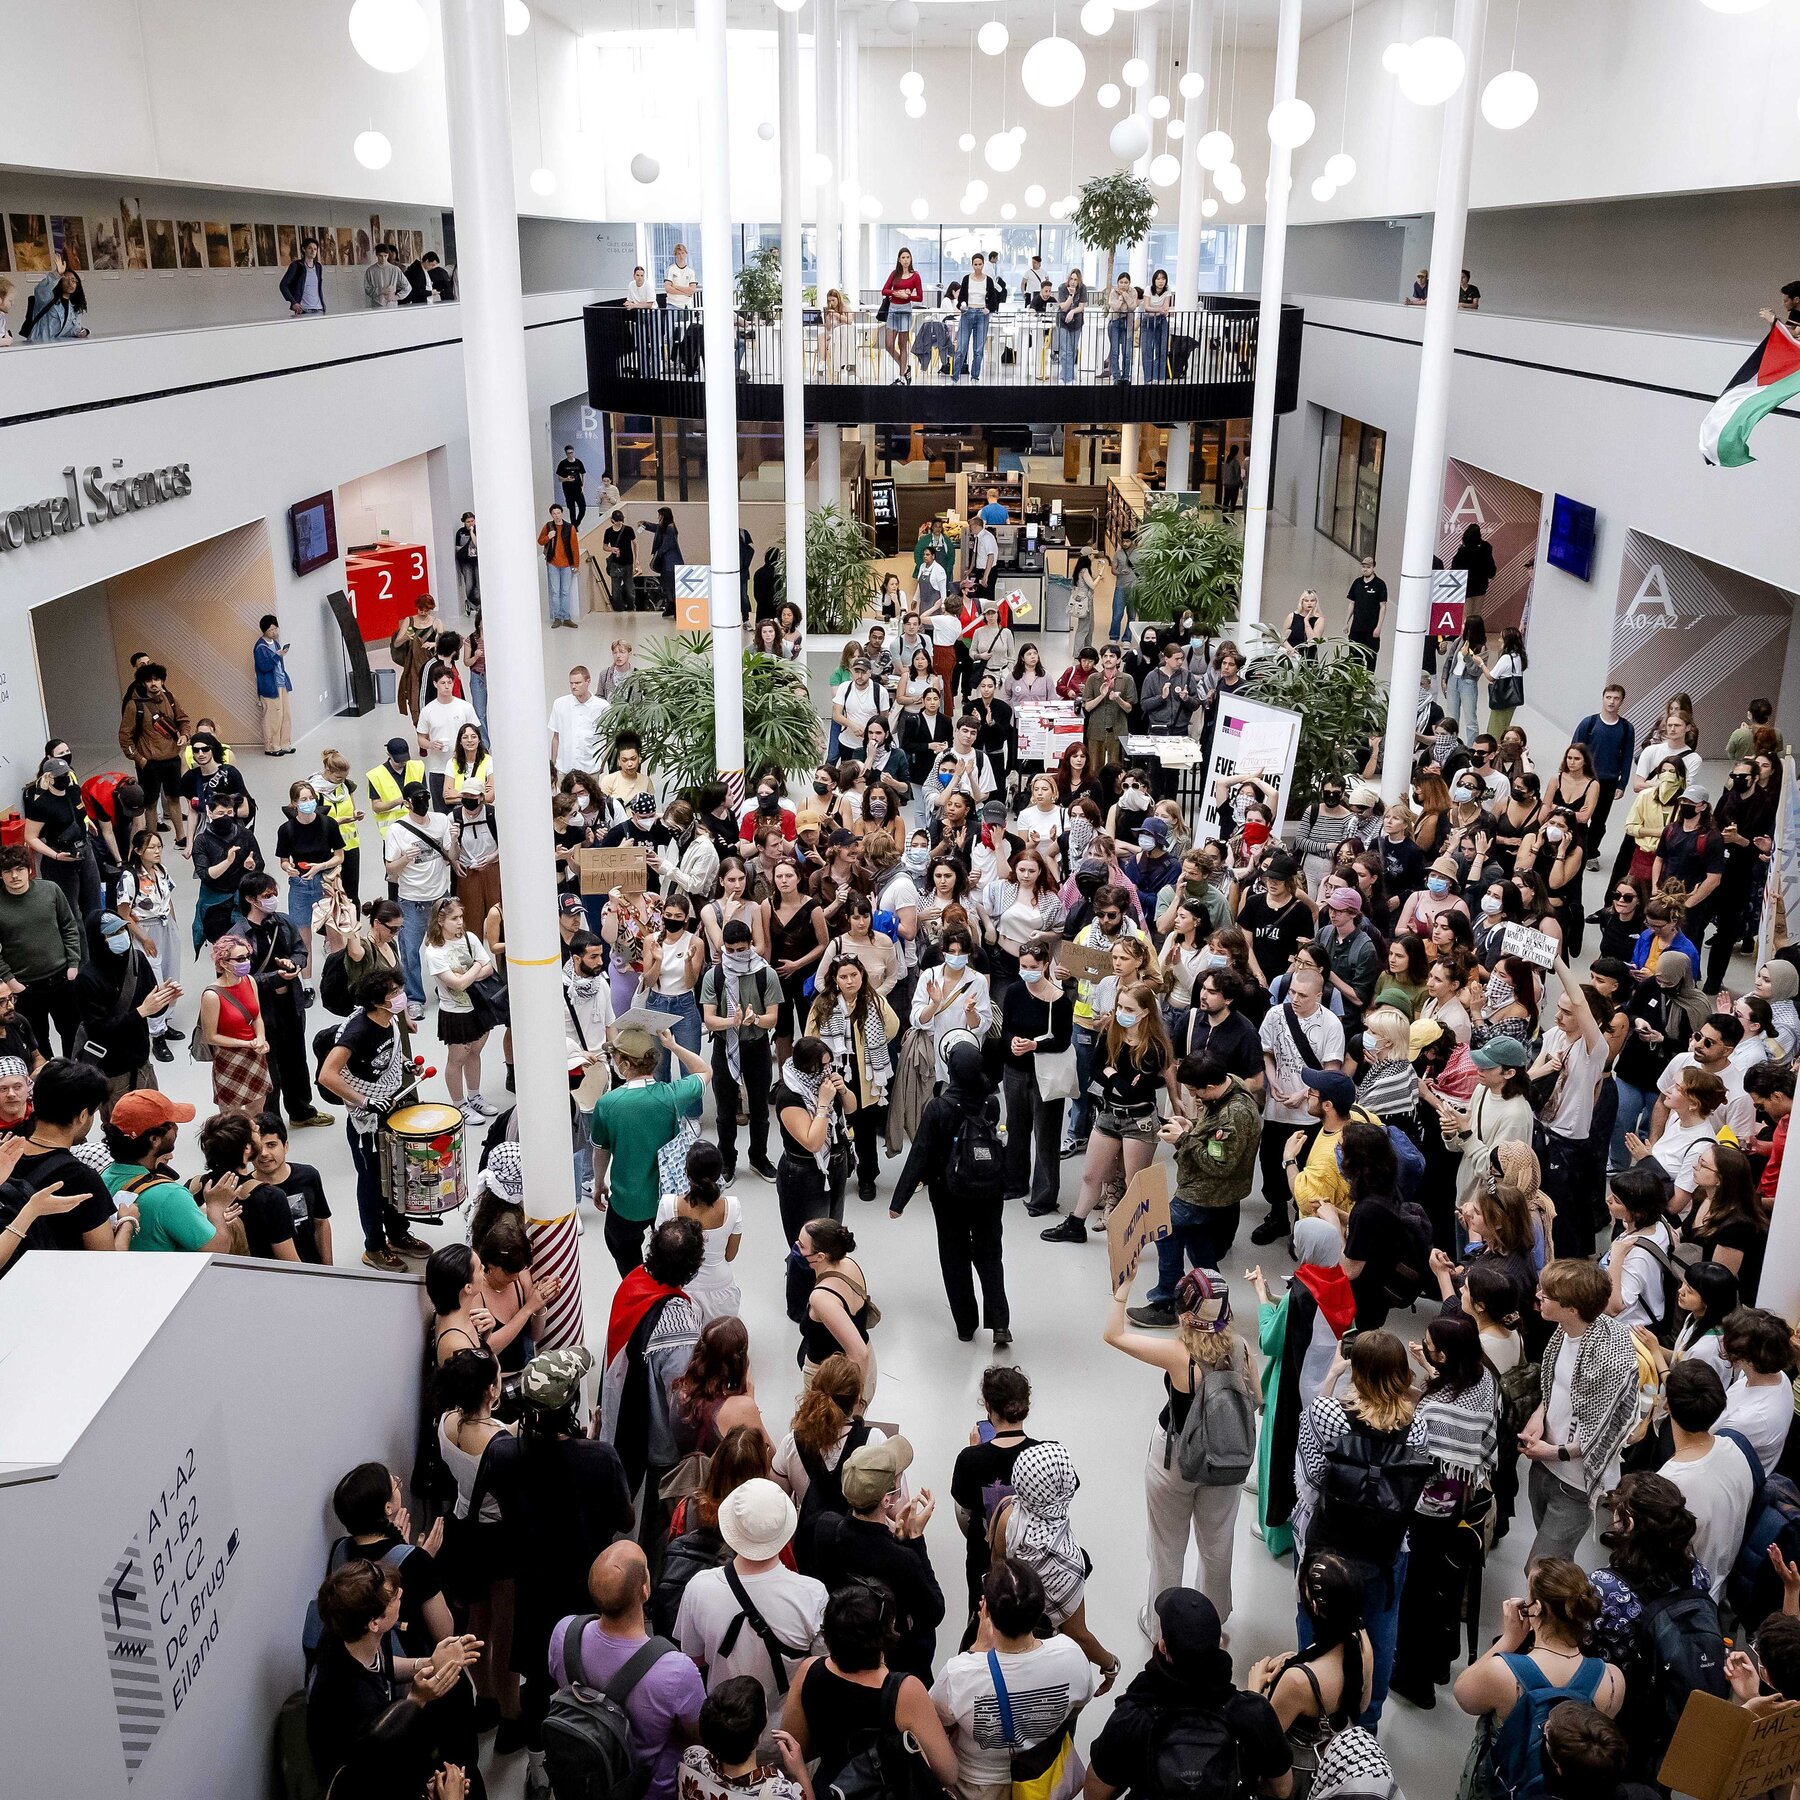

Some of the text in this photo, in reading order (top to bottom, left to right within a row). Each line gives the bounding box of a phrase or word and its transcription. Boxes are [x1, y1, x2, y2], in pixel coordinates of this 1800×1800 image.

[581, 405, 598, 431] B
[83, 458, 192, 523] Sciences
[1449, 485, 1486, 524] A
[410, 552, 424, 580] 3
[378, 570, 393, 600] 2
[1626, 565, 1676, 617] A
[347, 589, 358, 619] 1
[685, 605, 701, 624] C
[1437, 611, 1455, 629] A
[1620, 613, 1679, 630] A0-A2
[592, 853, 627, 868] FREE
[148, 1447, 197, 1544] A1-A2
[152, 1495, 200, 1586] B1-B2
[160, 1536, 206, 1626] C1-C2
[166, 1555, 226, 1672] De Brug
[172, 1608, 220, 1713] Eiland
